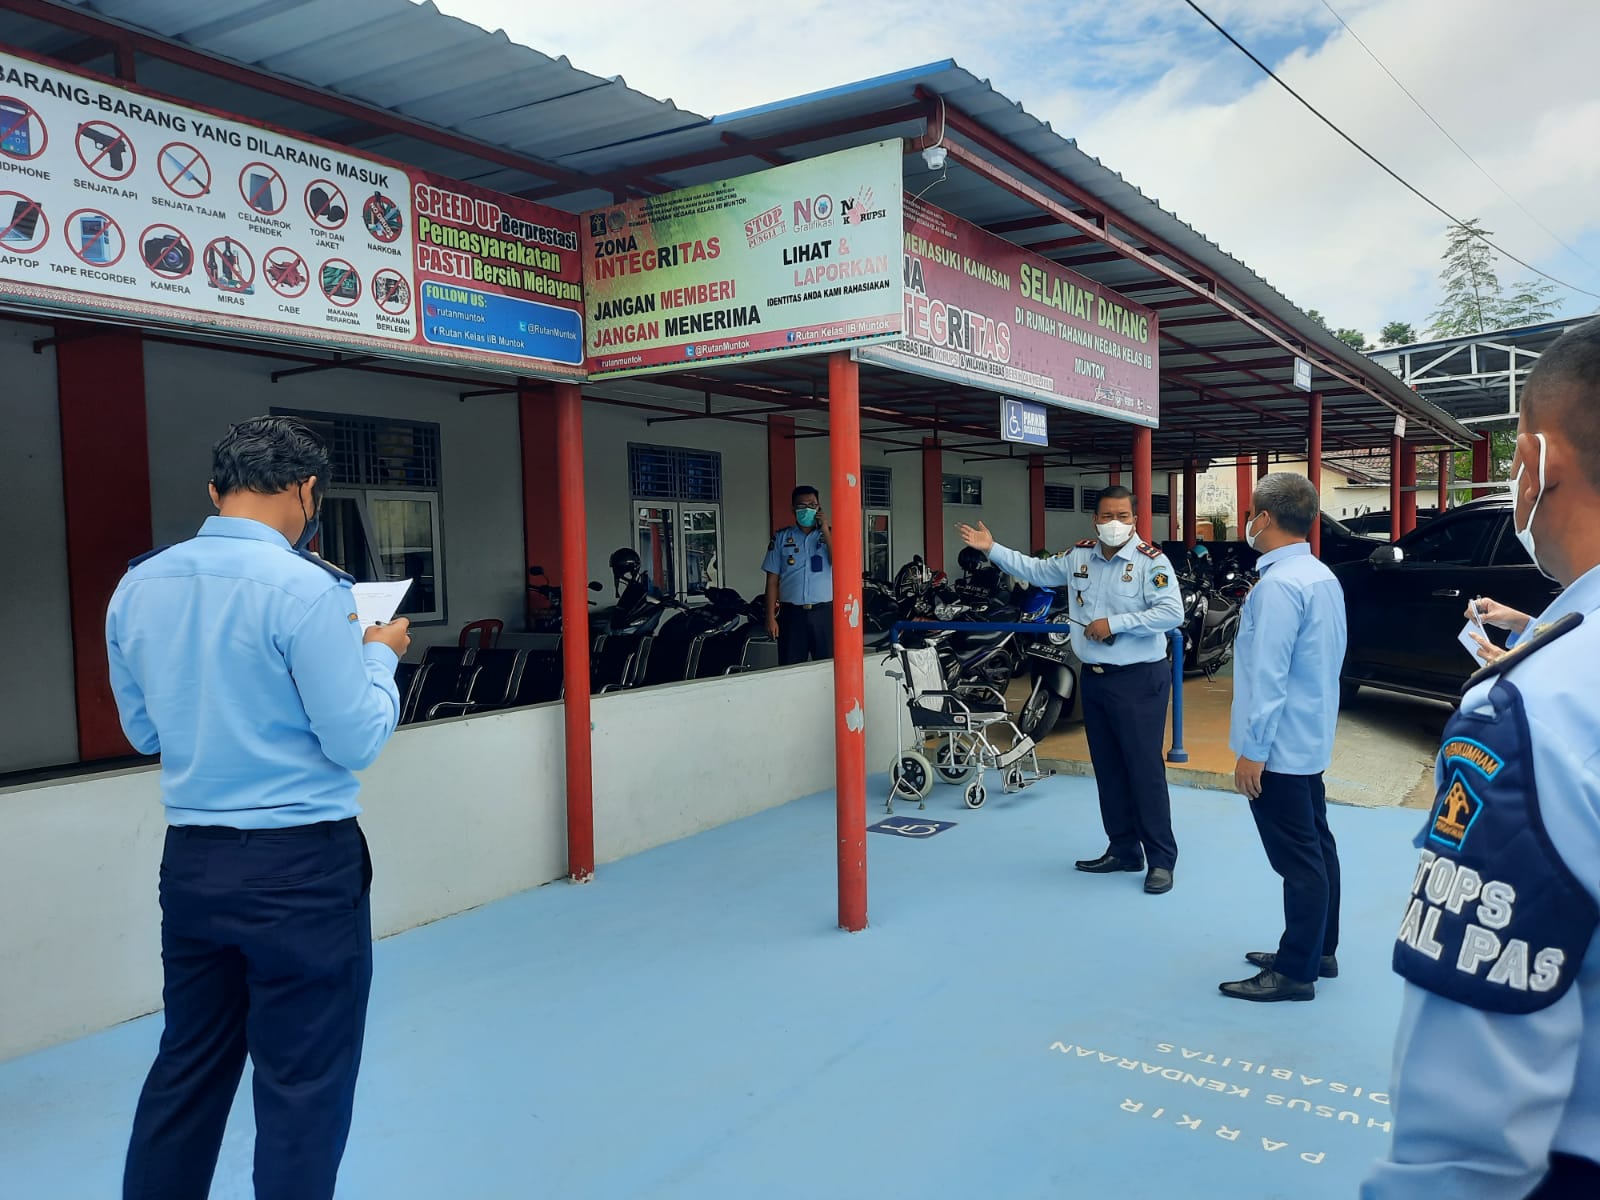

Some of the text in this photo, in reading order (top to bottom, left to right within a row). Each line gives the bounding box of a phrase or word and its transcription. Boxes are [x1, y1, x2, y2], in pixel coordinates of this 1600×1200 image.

[0, 65, 389, 189] BARANG-BARANG YANG DILARANG MASUK
[0, 161, 51, 180] DPHONE
[73, 179, 138, 200] SENJATA API
[151, 196, 227, 219] SENJATA TAJAM
[697, 205, 715, 213] KELAS
[724, 198, 747, 208] MUNTOK
[794, 194, 833, 225] NO
[238, 211, 292, 231] CELANA/ROK
[415, 183, 577, 251] SPEED UP Berprestasi
[744, 207, 783, 237] STOP
[793, 219, 835, 233] Gratifikasi
[248, 224, 283, 238] PENDEK
[310, 228, 345, 242] TOPI DAN
[315, 239, 340, 251] JAKET
[367, 243, 402, 256] NARKOBA
[419, 216, 561, 273] Pemasyarakatan
[594, 235, 638, 258] ZONA
[783, 236, 849, 266] LIHAT &
[0, 255, 40, 268] APTOP
[595, 236, 721, 281] INTEGRITAS
[903, 232, 1010, 291] MEMASUKI KAWASAN
[50, 263, 137, 285] TAPE RECORDER
[417, 244, 582, 302] PASTI Bersih Melayani
[794, 255, 888, 287] LAPORKAN
[150, 280, 191, 295] KAMERA
[426, 284, 487, 308] FOLLOW US:
[767, 280, 890, 307] IDENTITAS ANDA KAMI RAHASIAKAN
[217, 294, 246, 306] MIRAS
[278, 304, 301, 315] CABE
[594, 279, 736, 321] JANGAN MEMBERI
[1020, 263, 1148, 343] SELAMAT DATANG
[325, 315, 360, 326] BERAROMA
[327, 308, 358, 318] MAKANAN
[375, 313, 410, 326] MAKANAN
[437, 308, 486, 323] rutanmuntok
[376, 322, 410, 334] BERLEBIH
[527, 323, 577, 340] @RutanMuntok
[593, 304, 761, 348] JANGAN MENERIMA
[796, 329, 818, 341] Rutan
[821, 327, 843, 337] Kelas
[859, 320, 889, 332] Muntok
[439, 326, 462, 339] Rutan
[464, 331, 485, 343] Kelas
[498, 336, 525, 349] Muntok
[695, 339, 750, 357] @RutanMuntok
[1015, 306, 1152, 369] DI RUMAH TAHANAN NEGARA KELAS IIB
[897, 340, 919, 356] BEBAS
[920, 343, 933, 359] DARI
[601, 355, 642, 368] rutanmuntok
[1075, 357, 1105, 380] MUNTOK
[1457, 923, 1565, 992] PAS
[1155, 1042, 1391, 1105] DISABILITAS
[1050, 1041, 1392, 1133] HUSUS KENDARAAN
[1119, 1098, 1326, 1165] PARKIR
